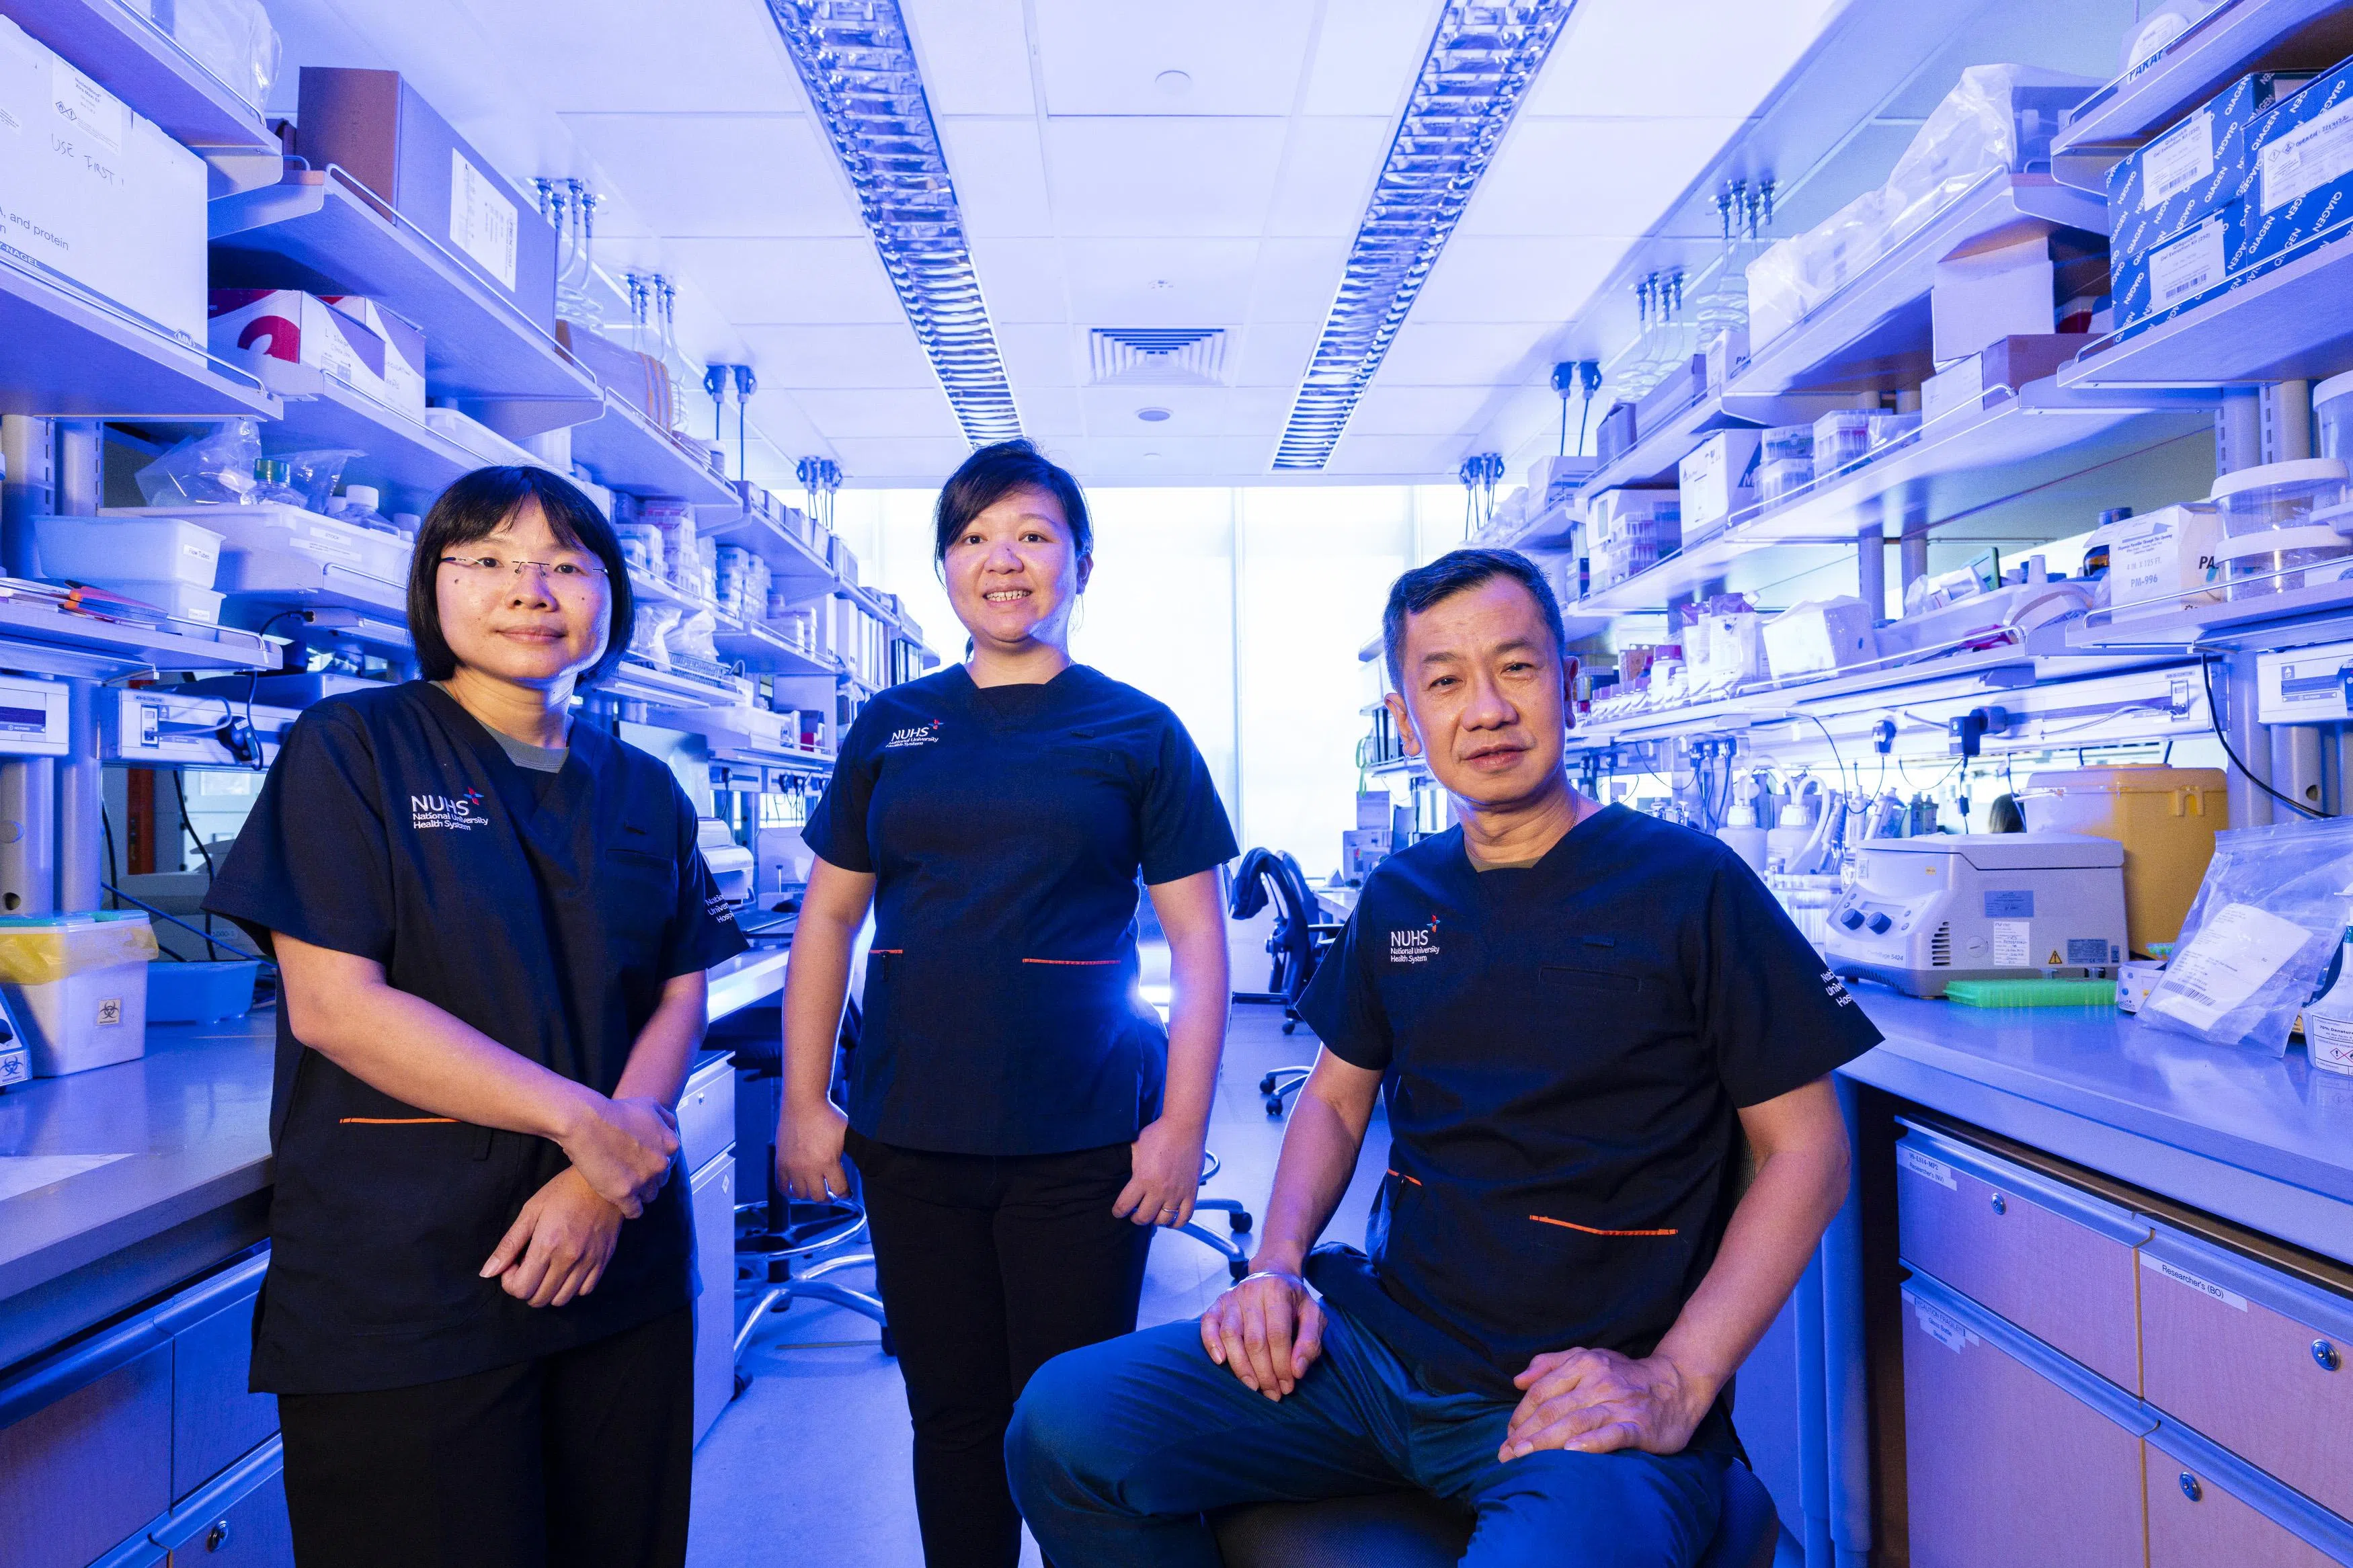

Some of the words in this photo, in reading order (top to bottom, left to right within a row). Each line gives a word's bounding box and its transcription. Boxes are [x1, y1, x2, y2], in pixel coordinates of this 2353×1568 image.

[51, 133, 74, 157] USE
[2215, 122, 2238, 160] QIAGEN
[2251, 110, 2280, 151] QIAGEN
[84, 155, 115, 185] FIRST
[2204, 167, 2228, 203] QIAGEN
[2118, 171, 2137, 204] QIAGEN
[2110, 210, 2129, 244] QIAGEN
[2313, 192, 2342, 232] QIAGEN
[10, 213, 30, 229] and
[34, 226, 68, 251] protein
[2127, 220, 2147, 254] QIAGEN
[2248, 216, 2276, 254] QIAGEN
[2124, 272, 2145, 305] QIAGEN
[2130, 574, 2158, 587] PM-996
[891, 727, 929, 742] NUHS
[411, 795, 469, 816] NUHS
[450, 814, 488, 825] University
[413, 820, 443, 829] Health
[444, 820, 471, 831] System
[1390, 930, 1429, 946] NUHS
[1414, 946, 1439, 954] University
[1408, 955, 1427, 964] System
[1890, 953, 1903, 961] 5424
[2162, 1264, 2205, 1290] Researcher's
[2207, 1286, 2224, 1299] (BO)
